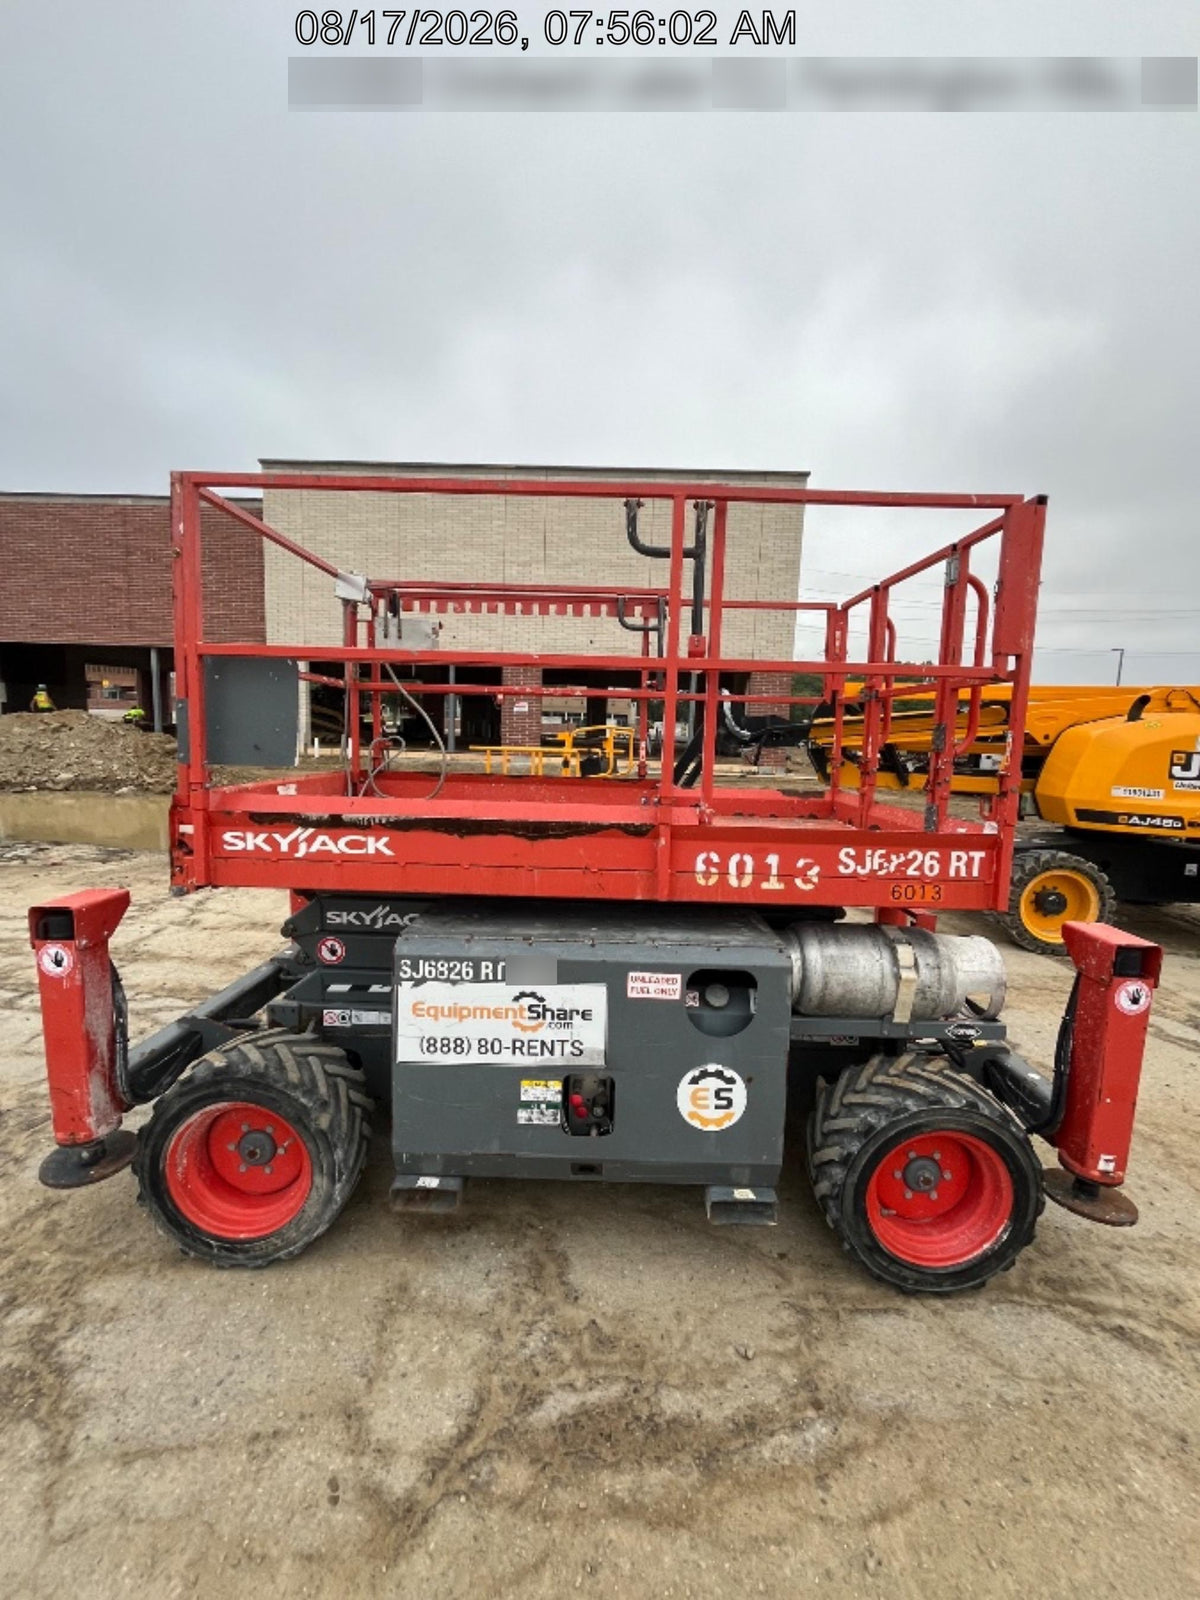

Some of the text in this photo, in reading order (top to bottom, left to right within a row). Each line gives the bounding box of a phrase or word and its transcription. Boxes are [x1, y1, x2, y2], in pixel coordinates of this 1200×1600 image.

[222, 826, 395, 857] SKYJACK
[695, 851, 820, 890] 6013
[949, 850, 986, 878] RT
[891, 884, 942, 901] 6013
[326, 905, 421, 928] SKYJAC
[400, 959, 474, 980] SJ6826
[630, 975, 679, 985] UNLEADED
[630, 986, 678, 996] FUEL ONLY
[411, 1001, 593, 1022] EquipmentShare
[419, 1036, 584, 1057] (888) 80-RENTS
[690, 1088, 734, 1110] ES
